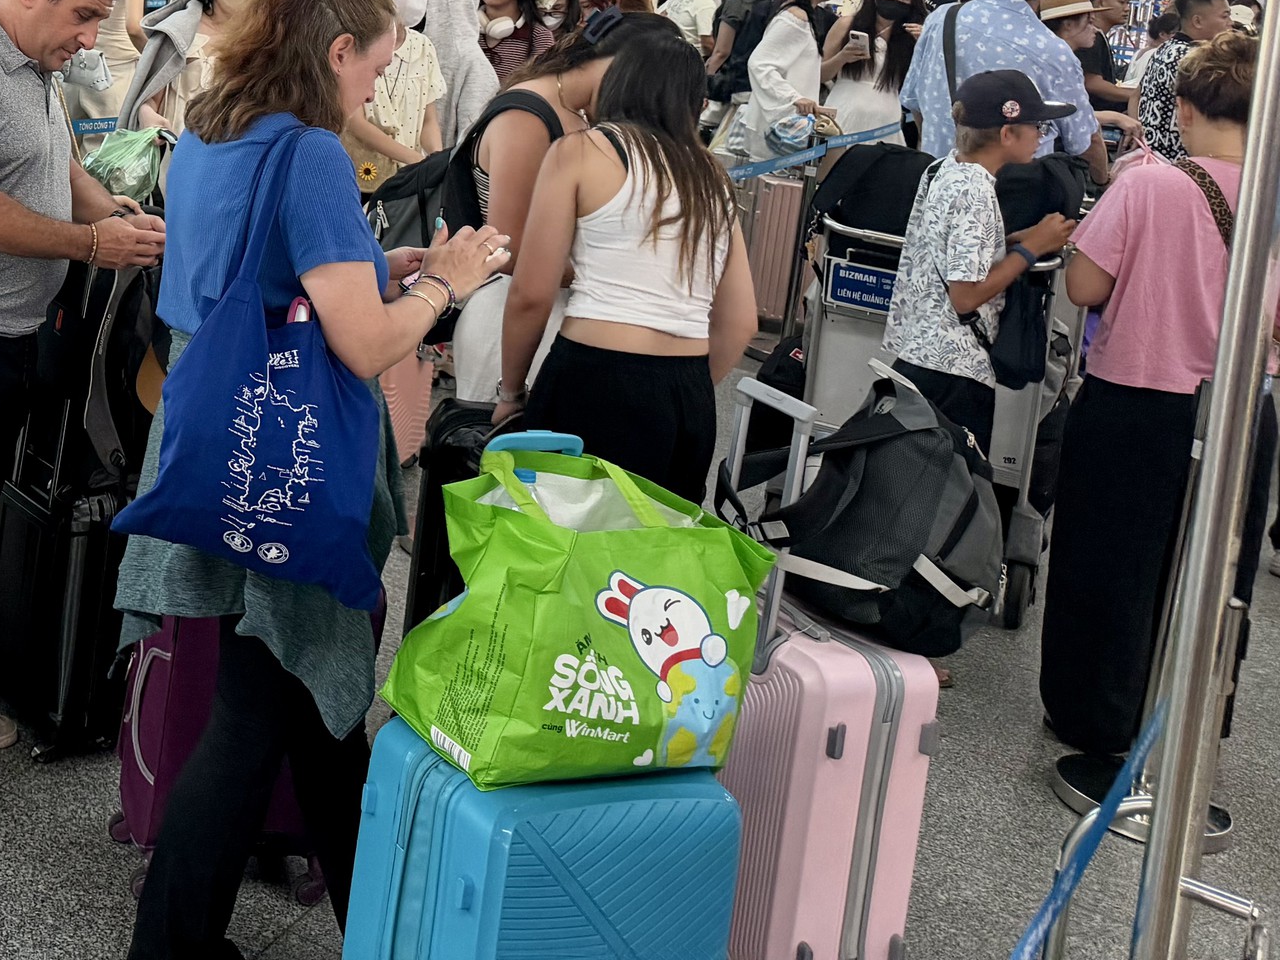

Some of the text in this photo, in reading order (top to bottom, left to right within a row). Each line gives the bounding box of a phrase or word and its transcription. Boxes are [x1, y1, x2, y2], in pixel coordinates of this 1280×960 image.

[839, 269, 877, 284] BIZMAN
[837, 288, 852, 298] LIÊN
[852, 291, 862, 302] HỆ
[550, 648, 635, 701] SỐNG
[542, 685, 640, 725] XANH
[541, 718, 630, 743] cùng WinMart
